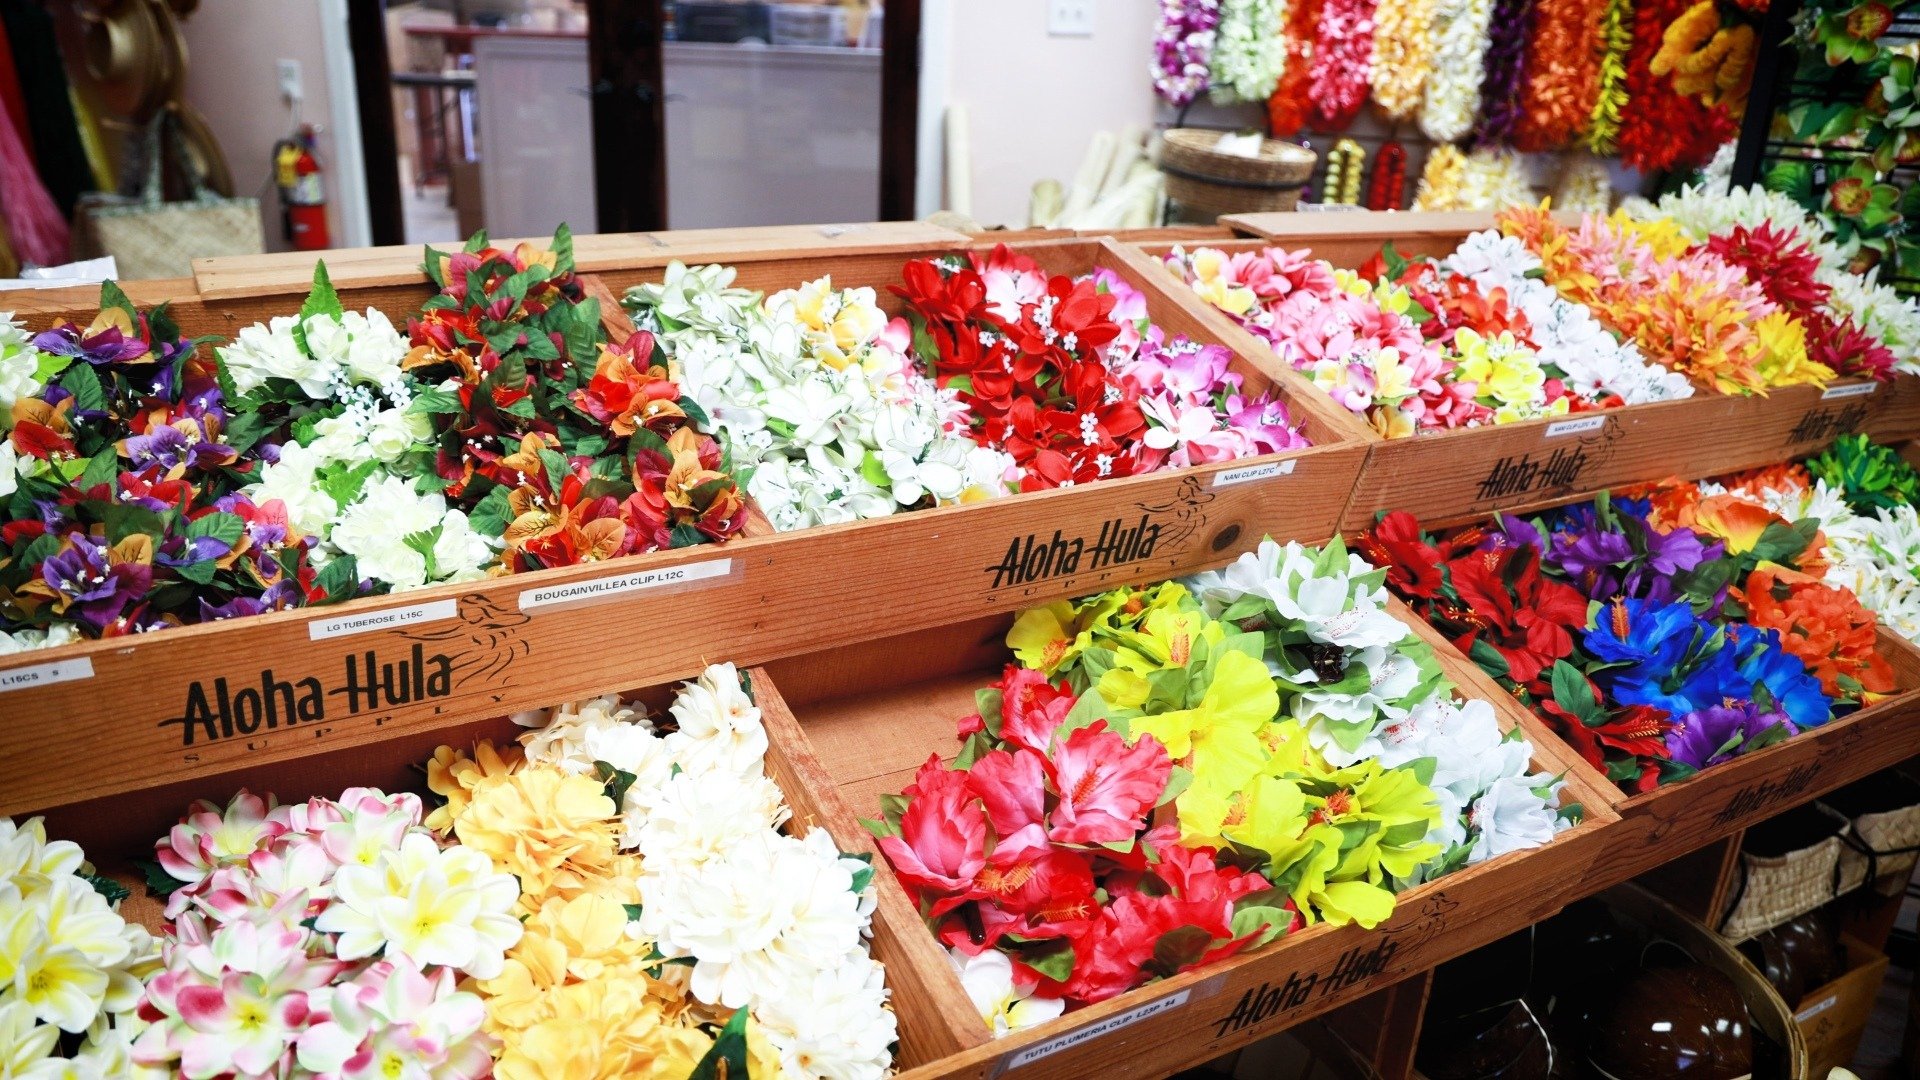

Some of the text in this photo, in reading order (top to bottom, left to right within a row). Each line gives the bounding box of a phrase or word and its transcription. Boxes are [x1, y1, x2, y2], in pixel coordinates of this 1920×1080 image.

[1223, 467, 1275, 481] NANI CLIP L27C
[1476, 453, 1539, 500] Aloha
[1537, 445, 1587, 489] Hula
[984, 514, 1161, 589] Aloha Hula
[534, 570, 684, 603] BOUGAINVILLEA CLIP L12C
[986, 559, 1178, 604] SUPPLY
[327, 610, 423, 632] LG TUBEROSE L15C
[157, 643, 452, 745] Aloha Hula
[183, 693, 506, 764] SUPPLY
[1211, 971, 1318, 1038] Aloha
[1317, 935, 1399, 997] Hula
[1024, 998, 1176, 1060] TUTU PLUMERIA CLIP L23P $4
